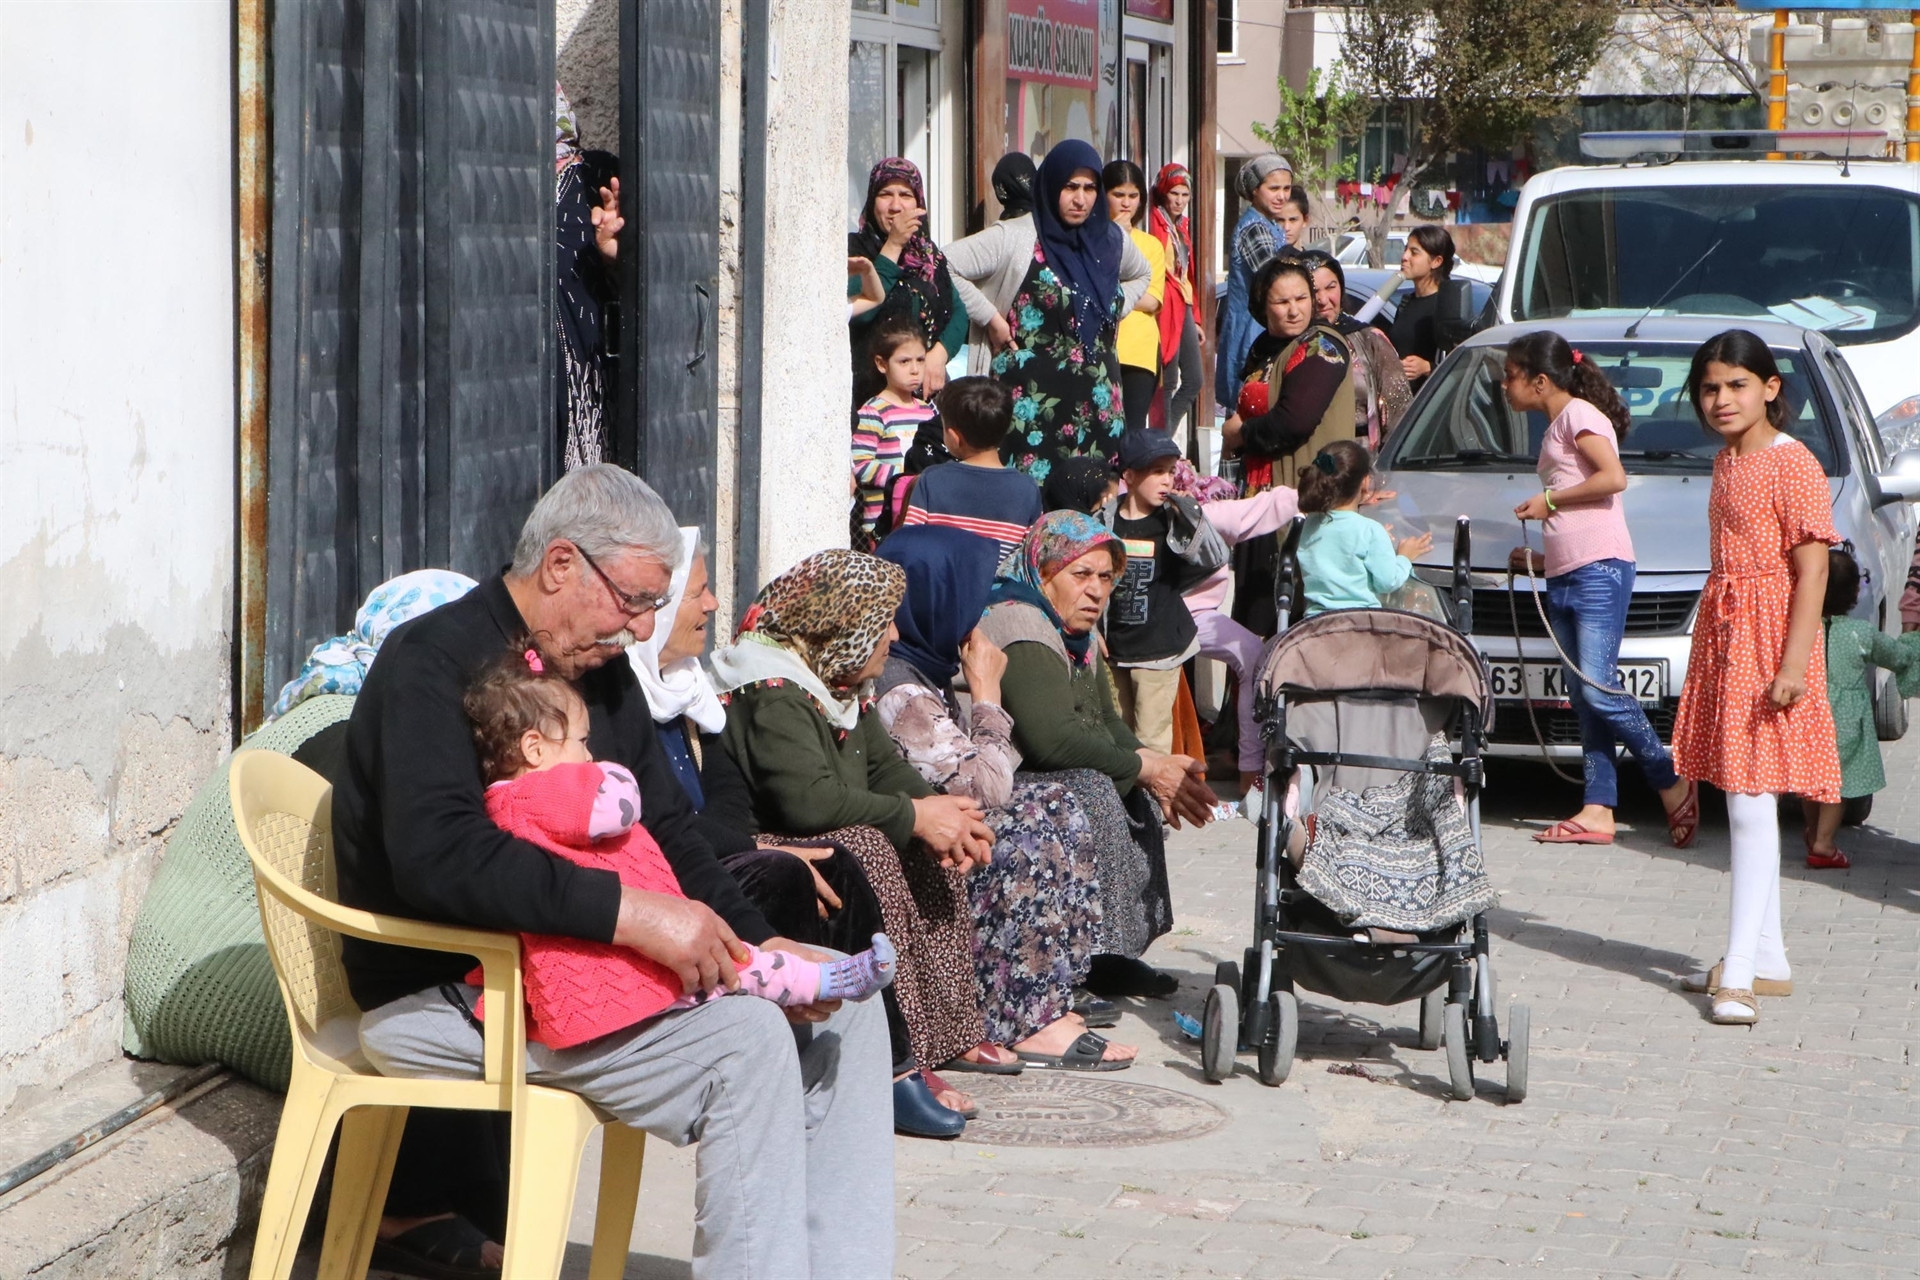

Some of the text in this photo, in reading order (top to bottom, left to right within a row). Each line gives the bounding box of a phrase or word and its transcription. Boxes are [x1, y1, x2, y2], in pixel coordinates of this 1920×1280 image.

[1008, 6, 1094, 81] KUAFÖR SALONU
[1491, 666, 1522, 695] 63
